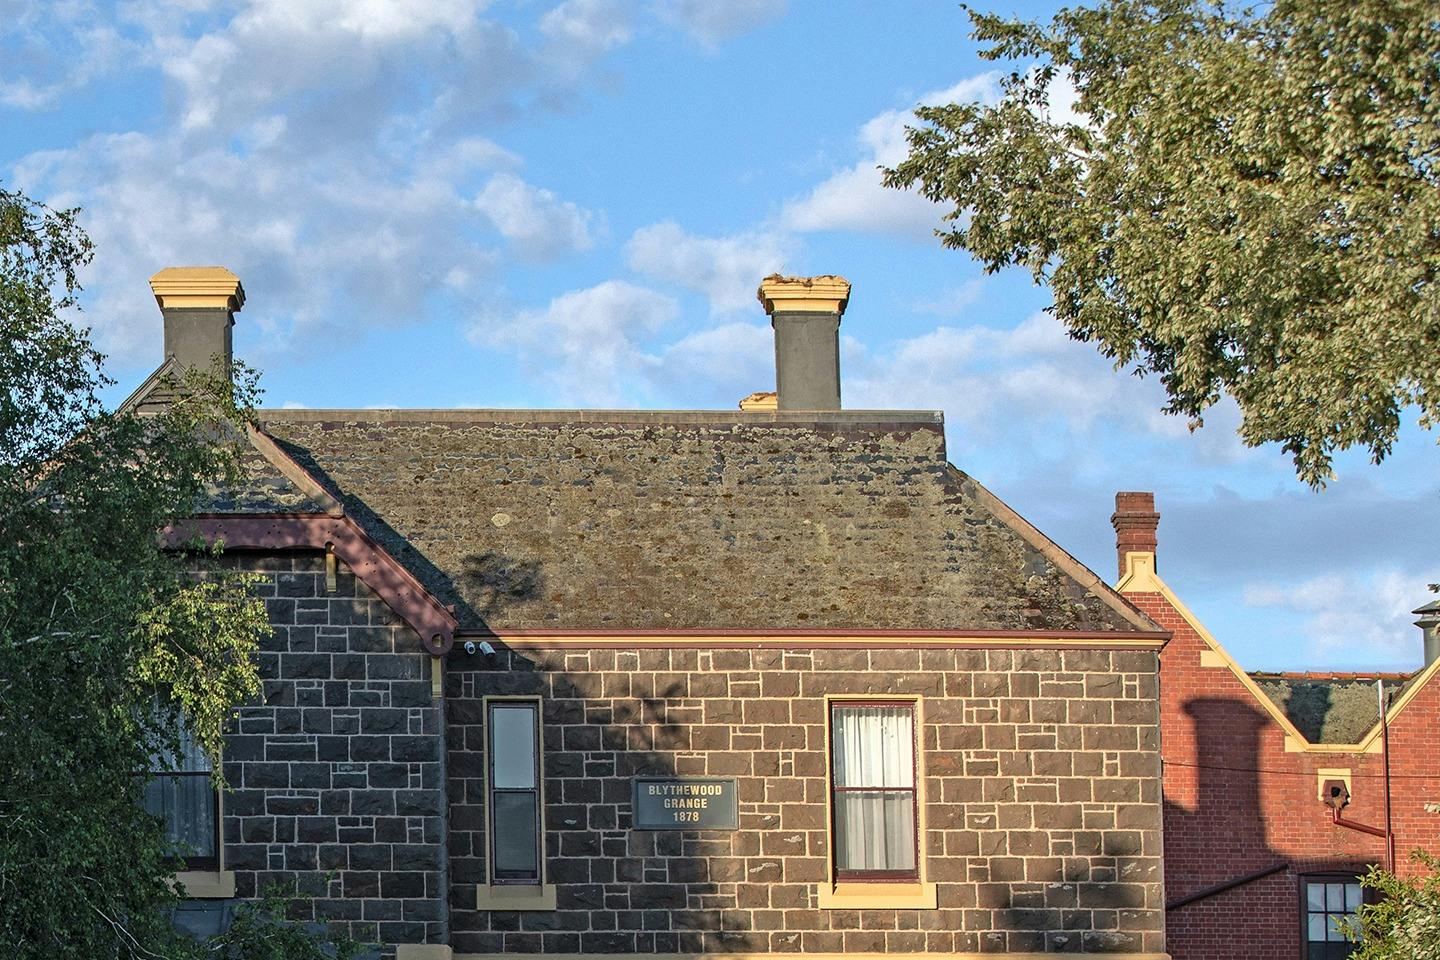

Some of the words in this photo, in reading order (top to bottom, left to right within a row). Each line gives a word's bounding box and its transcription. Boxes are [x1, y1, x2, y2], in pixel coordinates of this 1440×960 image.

[648, 785, 722, 796] BLYTHEWOOD
[664, 798, 708, 809] GRANGE
[673, 812, 700, 822] 1878
